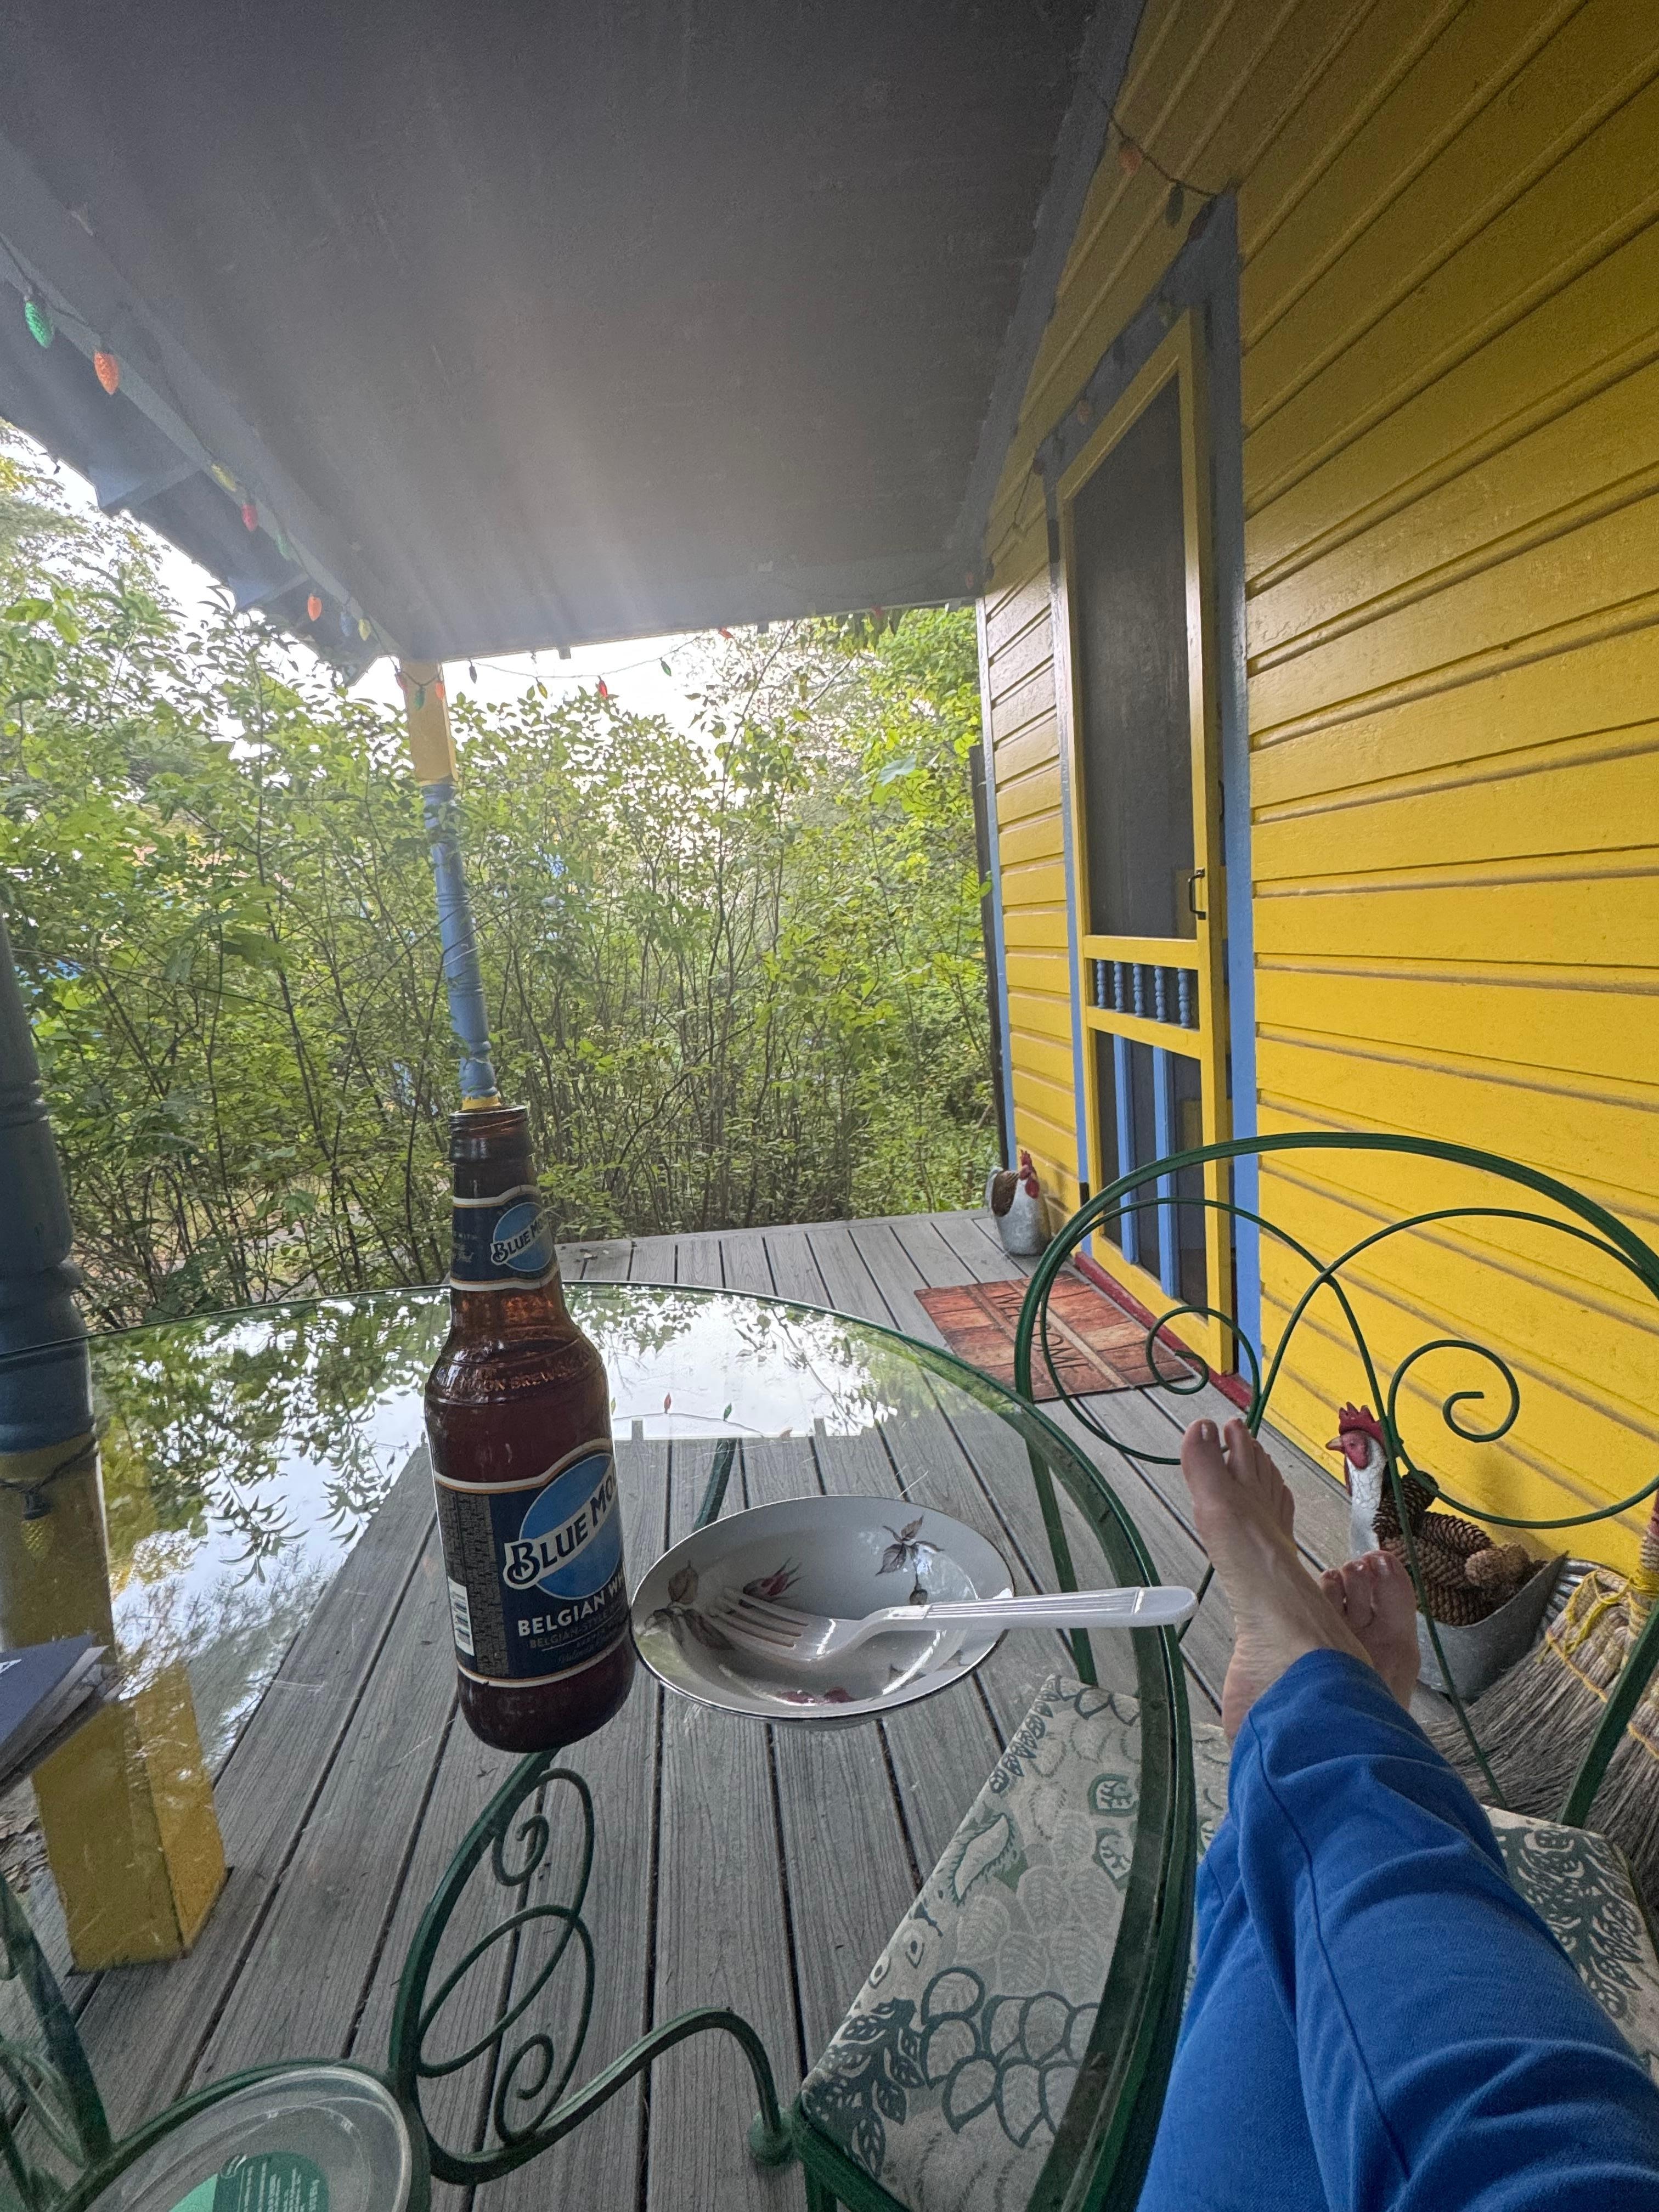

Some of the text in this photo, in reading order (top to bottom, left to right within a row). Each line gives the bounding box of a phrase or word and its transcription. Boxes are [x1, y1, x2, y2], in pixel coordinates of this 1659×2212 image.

[493, 1232, 531, 1263] BLUE
[507, 1513, 588, 1584] BLUE
[518, 1590, 605, 1637] BELGIAN
